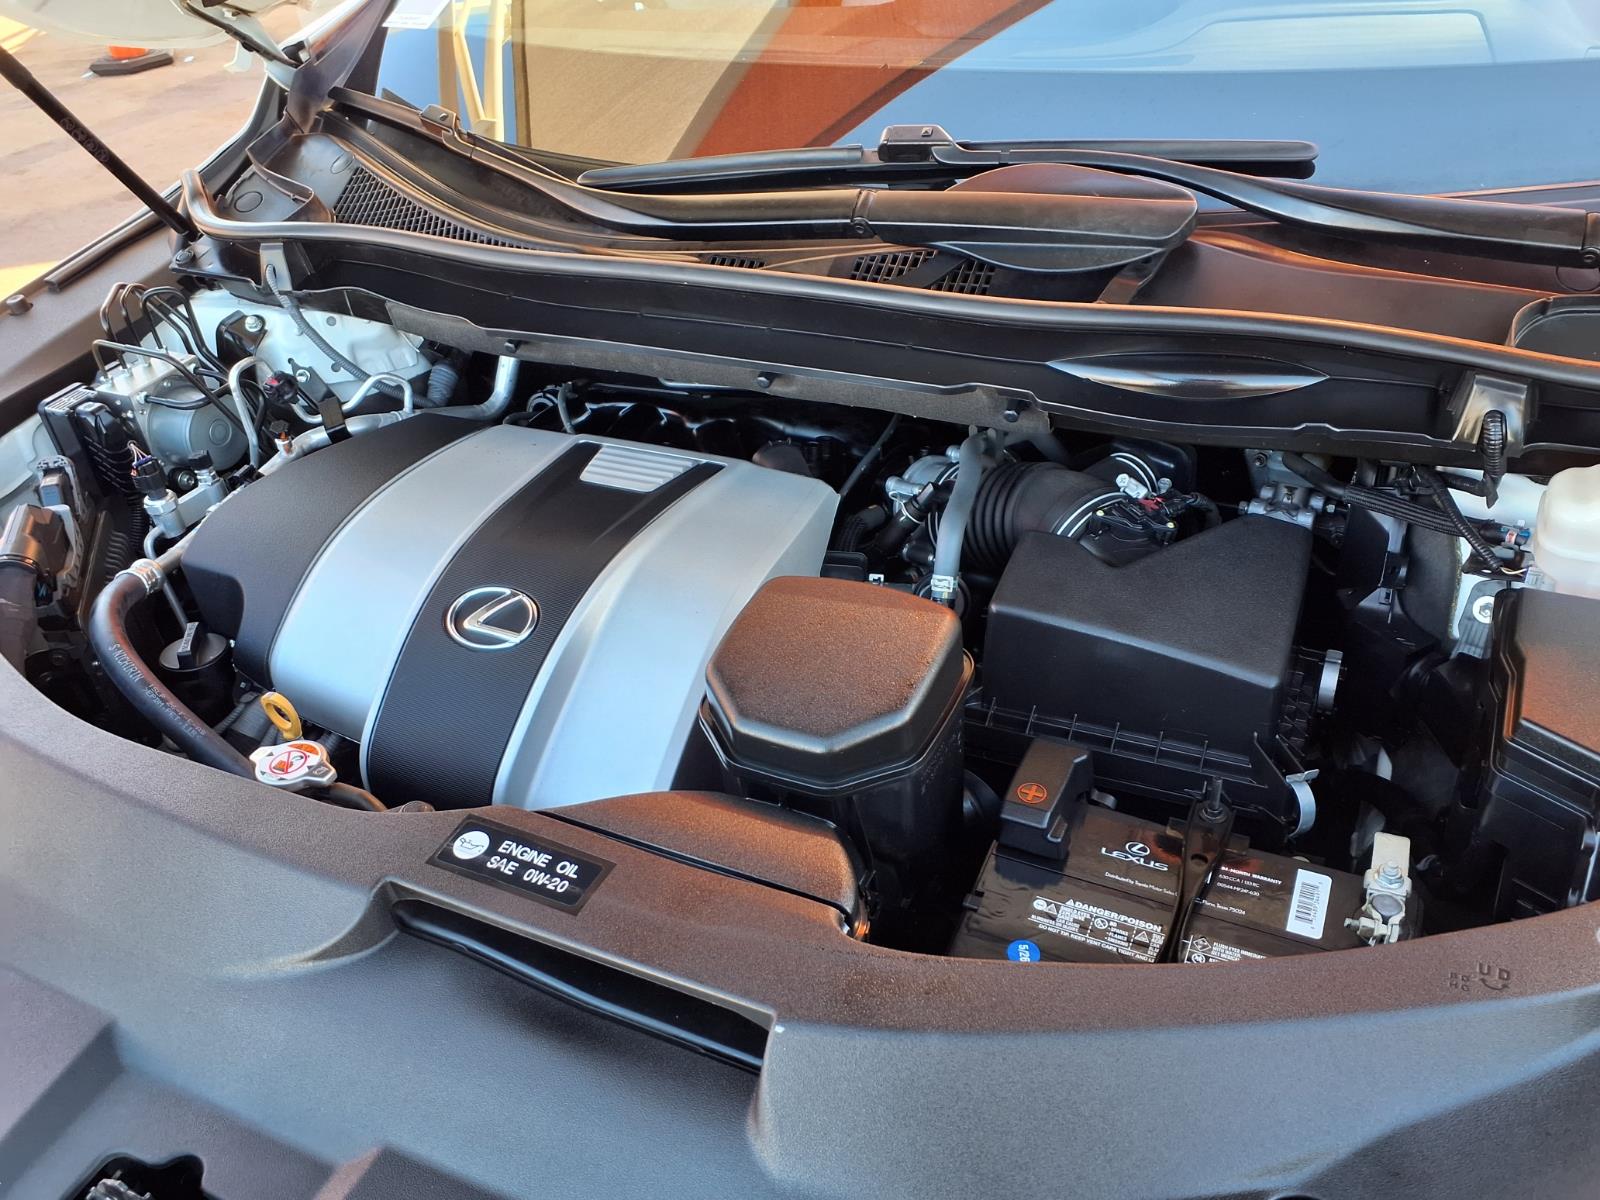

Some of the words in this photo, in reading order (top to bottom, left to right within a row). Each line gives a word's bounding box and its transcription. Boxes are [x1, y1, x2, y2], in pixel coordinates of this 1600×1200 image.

[498, 841, 552, 868] ENGINE
[556, 861, 578, 879] OIL
[1101, 847, 1169, 871] LEXUS
[486, 856, 519, 876] SAE
[523, 869, 569, 893] 0W-20
[1105, 872, 1128, 883] Distributed
[1135, 880, 1149, 888] Toyota
[1251, 873, 1282, 885] WARRANTY
[1074, 901, 1162, 933] DANGER/POISON
[1087, 938, 1101, 946] VENT
